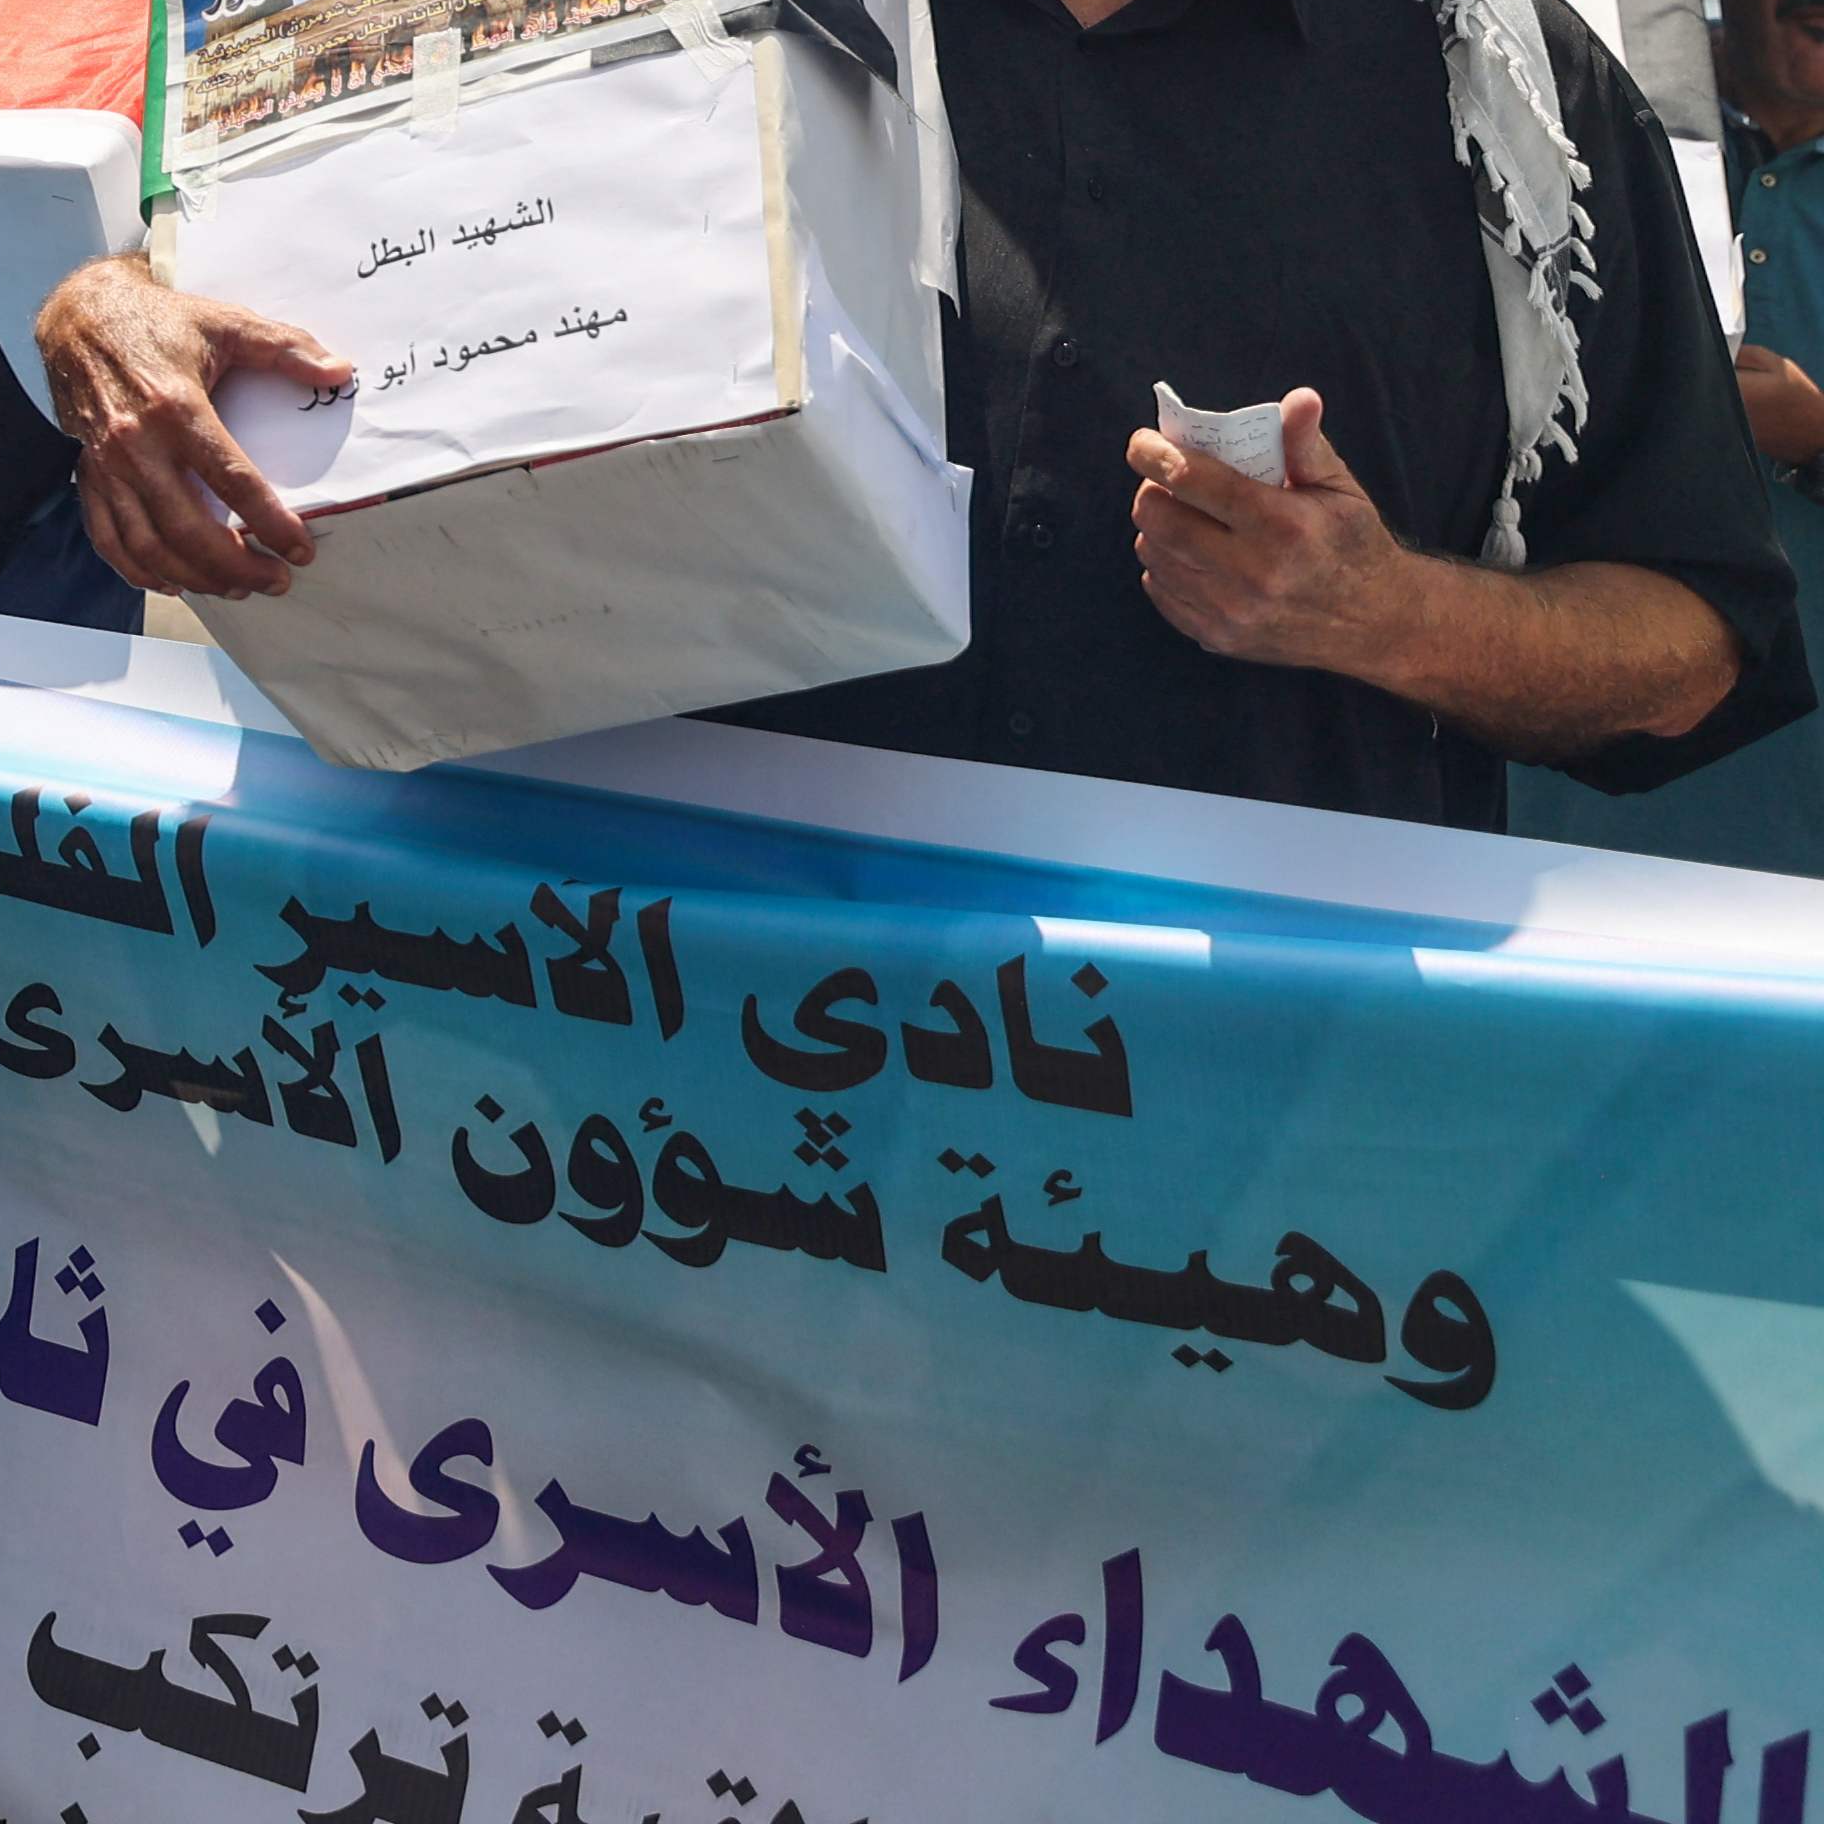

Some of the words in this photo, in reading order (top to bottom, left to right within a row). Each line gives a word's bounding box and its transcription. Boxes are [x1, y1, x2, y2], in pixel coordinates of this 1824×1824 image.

[357, 227, 436, 279] البطل
[451, 196, 554, 250] الشهيد
[374, 343, 417, 391] أبو
[432, 327, 538, 372] محمود
[554, 305, 628, 339] مهند
[741, 954, 1134, 1131] نادي
[449, 1094, 889, 1270] شؤون
[935, 1144, 1499, 1412] وهيئة
[152, 1297, 306, 1558] في
[355, 1417, 940, 1683] الأسرى
[27, 1612, 470, 1824] ترتكب
[988, 1546, 1811, 1824] الشهداء
